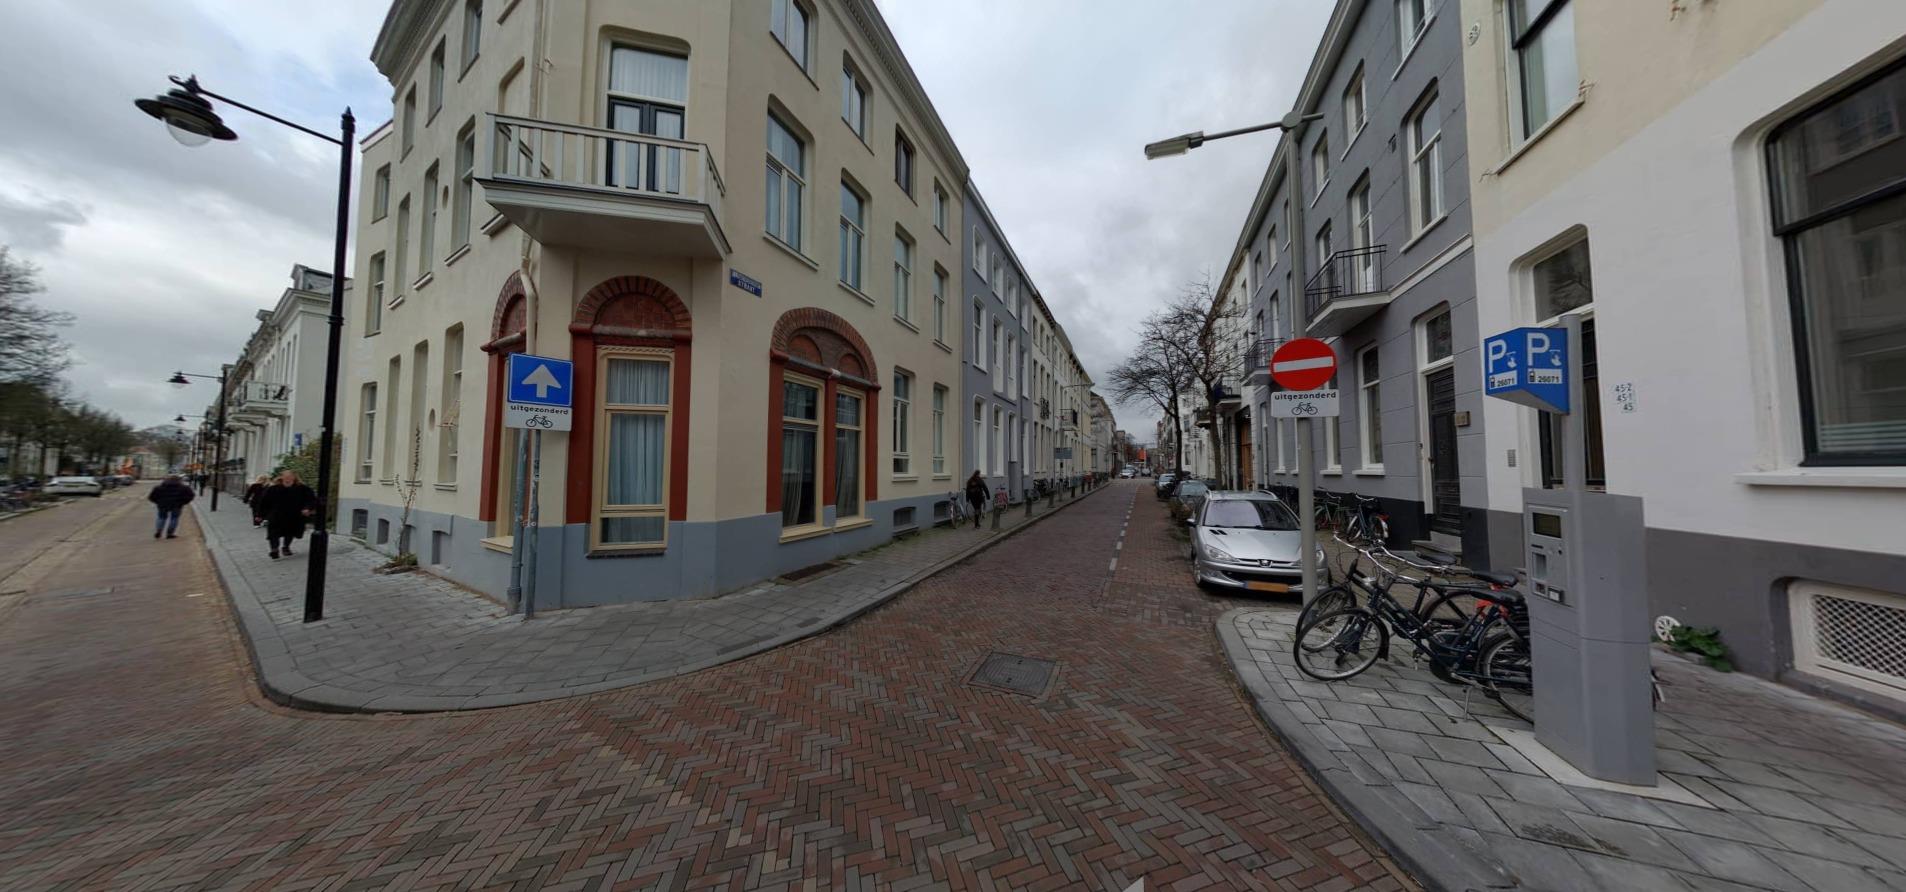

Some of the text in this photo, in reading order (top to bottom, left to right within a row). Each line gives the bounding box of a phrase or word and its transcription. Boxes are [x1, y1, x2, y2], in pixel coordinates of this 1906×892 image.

[1488, 339, 1507, 374] P
[1527, 332, 1550, 366] P
[1274, 391, 1336, 401] uitgezonderd
[510, 404, 569, 415] uitgezonderd
